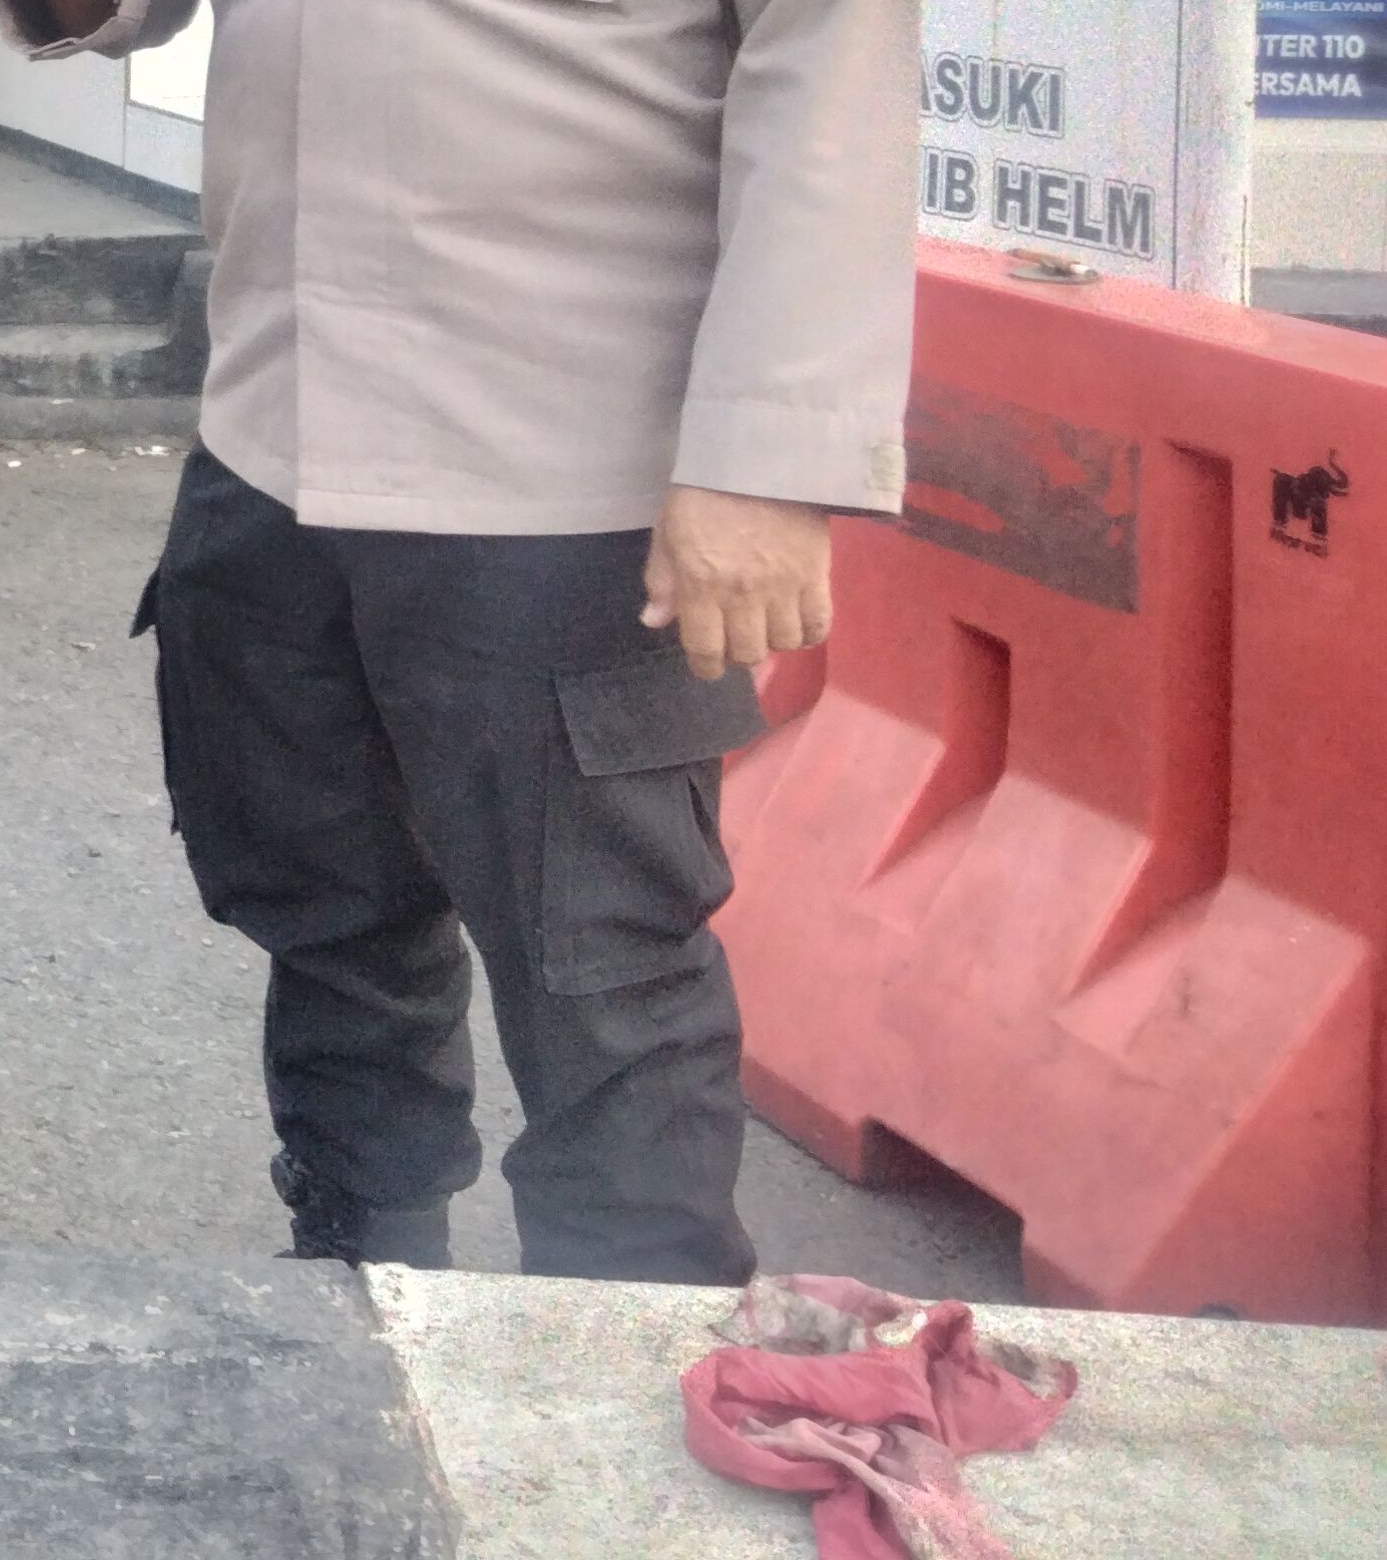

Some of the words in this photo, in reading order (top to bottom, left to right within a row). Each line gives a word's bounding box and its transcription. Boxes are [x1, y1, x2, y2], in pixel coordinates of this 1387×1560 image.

[1255, 34, 1316, 59] TER
[1322, 34, 1365, 59] 110
[992, 158, 1156, 261] HELM
